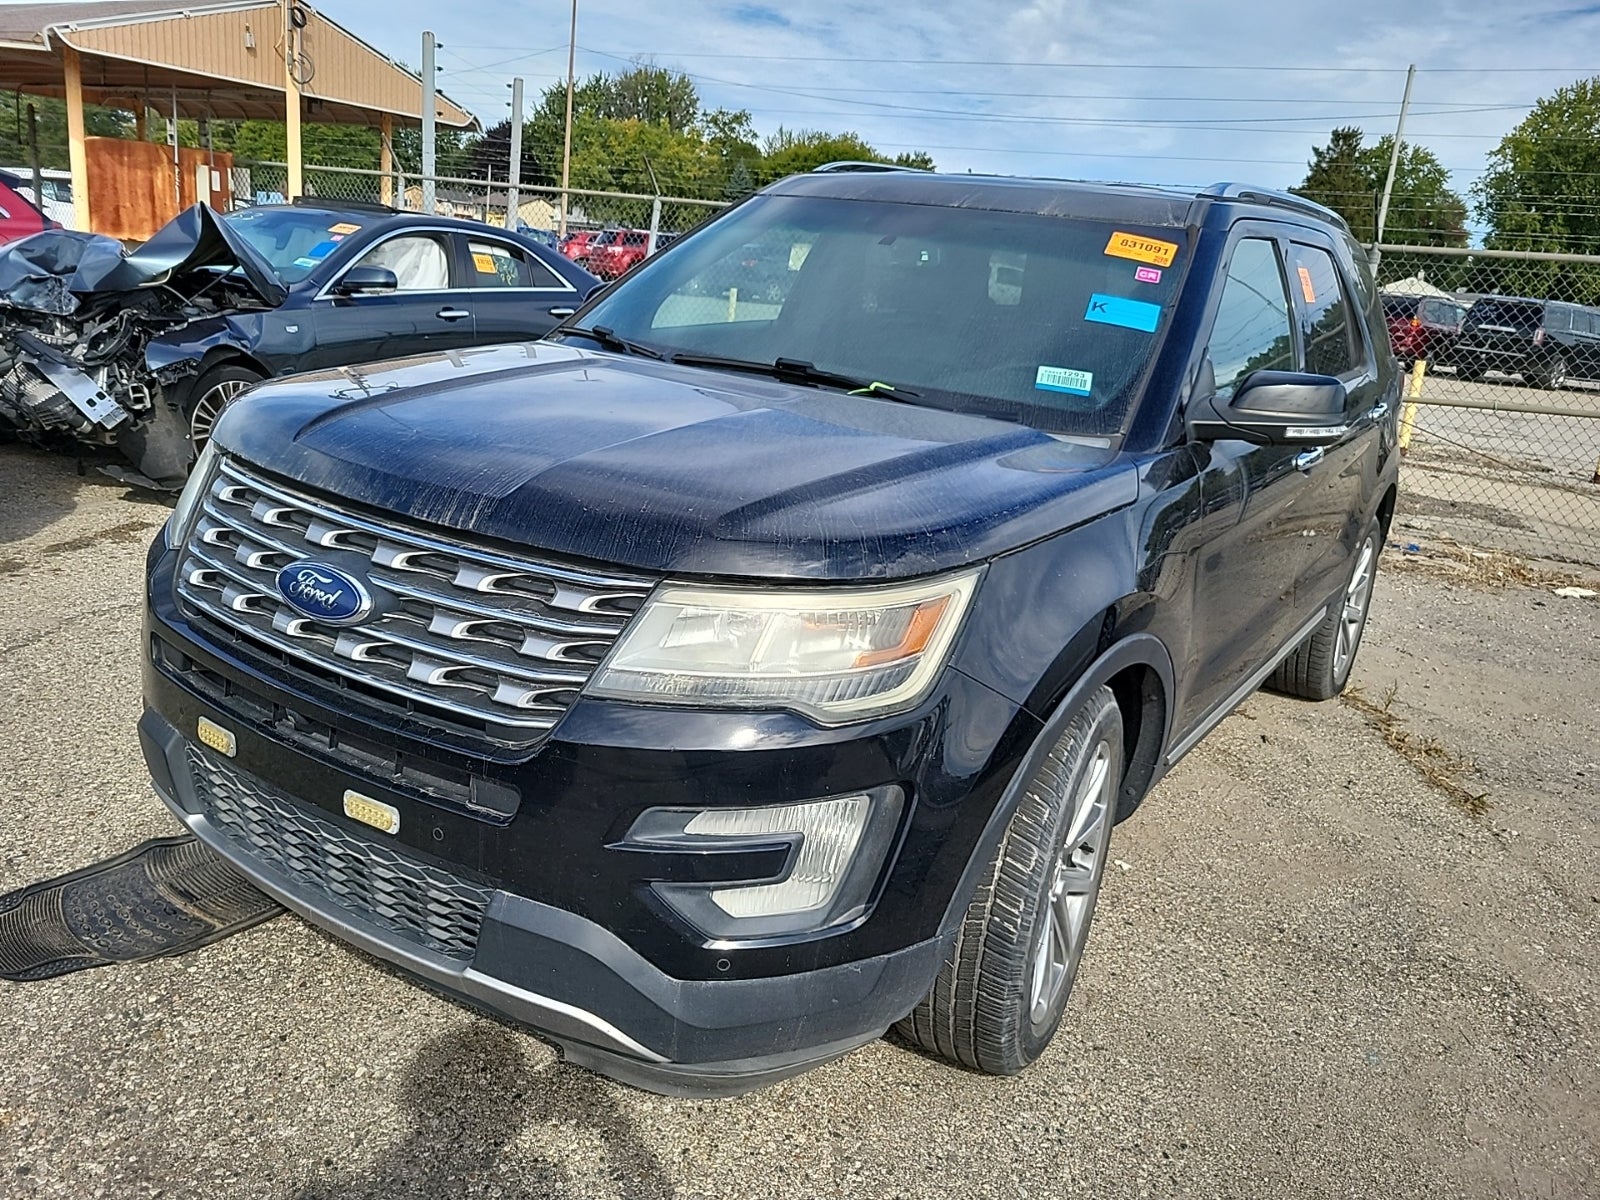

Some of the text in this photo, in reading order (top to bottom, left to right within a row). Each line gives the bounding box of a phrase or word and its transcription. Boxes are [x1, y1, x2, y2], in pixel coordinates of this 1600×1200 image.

[1120, 239, 1169, 256] 831091
[1091, 301, 1108, 313] K
[1063, 370, 1085, 379] 1293
[289, 569, 343, 611] Ford
